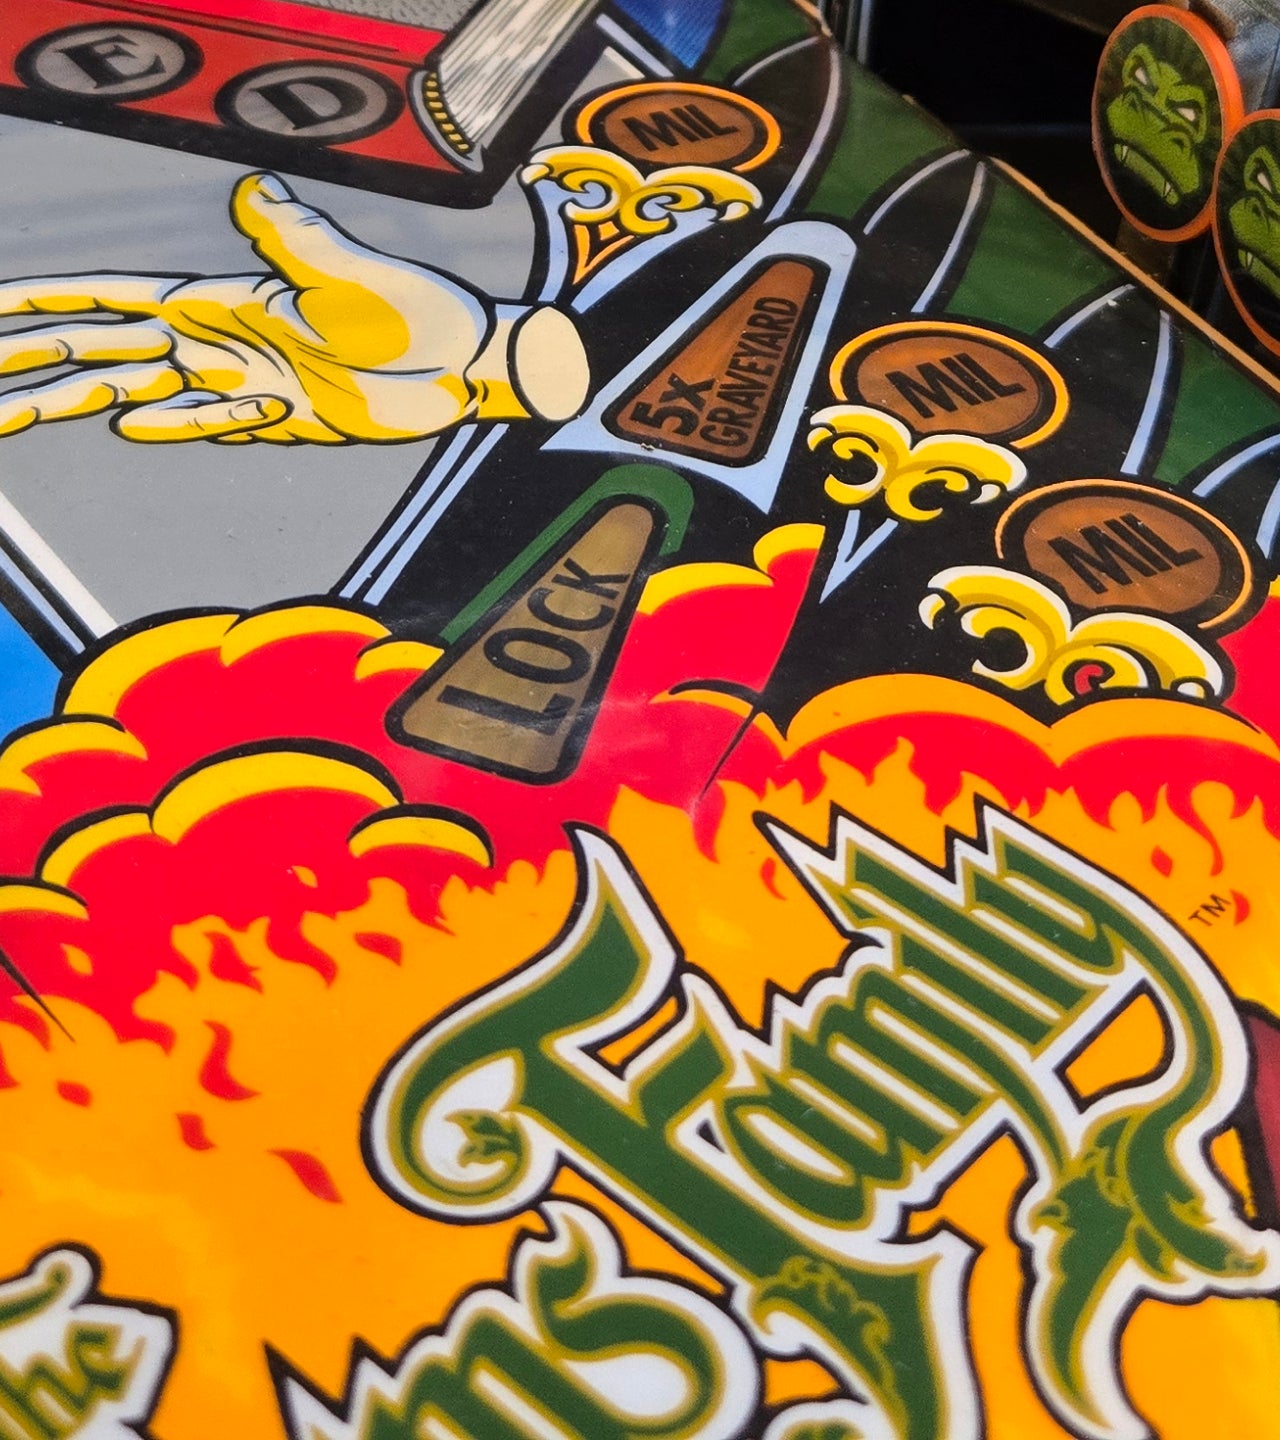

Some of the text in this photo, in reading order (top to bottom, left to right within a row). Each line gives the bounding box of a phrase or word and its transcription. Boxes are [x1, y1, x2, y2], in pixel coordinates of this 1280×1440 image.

[54, 32, 166, 90] E
[250, 73, 369, 131] D
[621, 103, 740, 153] MIL
[699, 296, 799, 447] GRAVEYARD
[885, 352, 1026, 420] MIL
[1047, 512, 1204, 595] MIL
[437, 558, 632, 737] LOCK
[1187, 892, 1232, 927] TM
